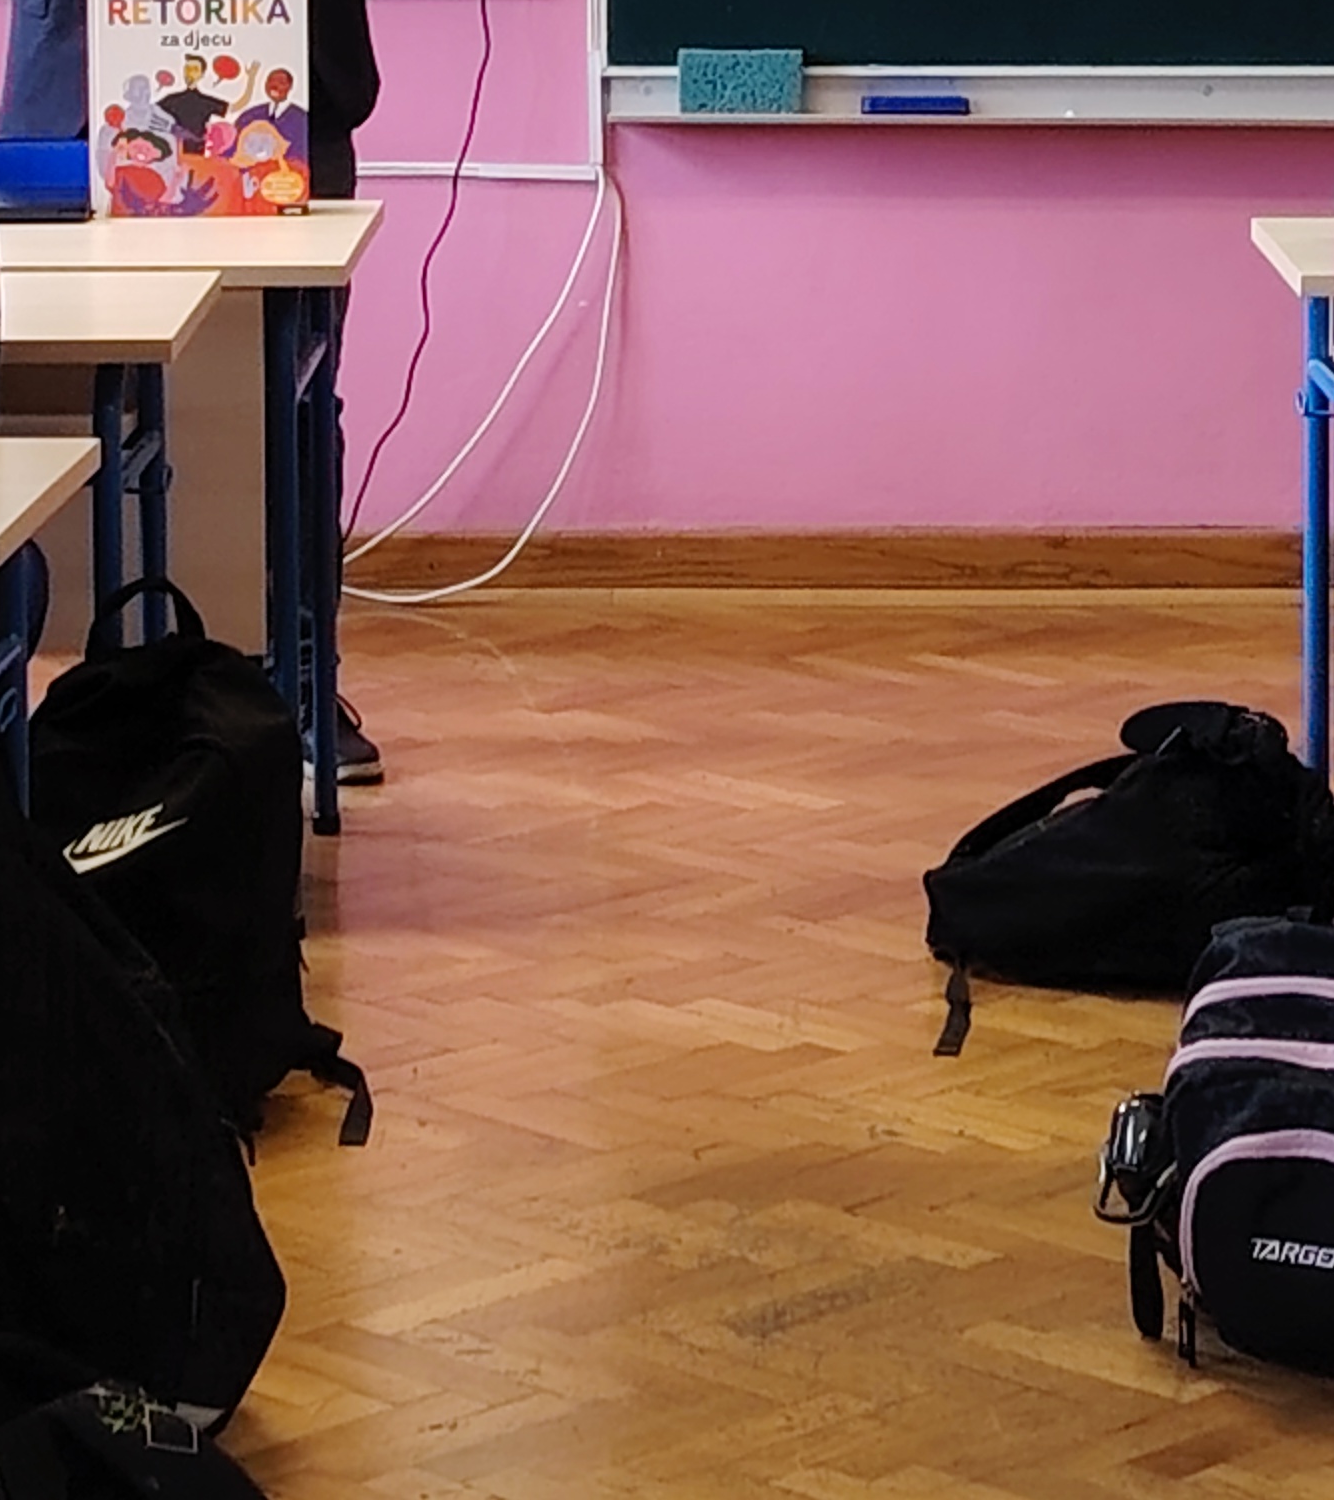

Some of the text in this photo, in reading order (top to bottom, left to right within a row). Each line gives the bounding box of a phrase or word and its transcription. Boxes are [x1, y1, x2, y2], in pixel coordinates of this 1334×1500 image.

[160, 30, 233, 51] za djecu
[72, 803, 165, 855] NIKE
